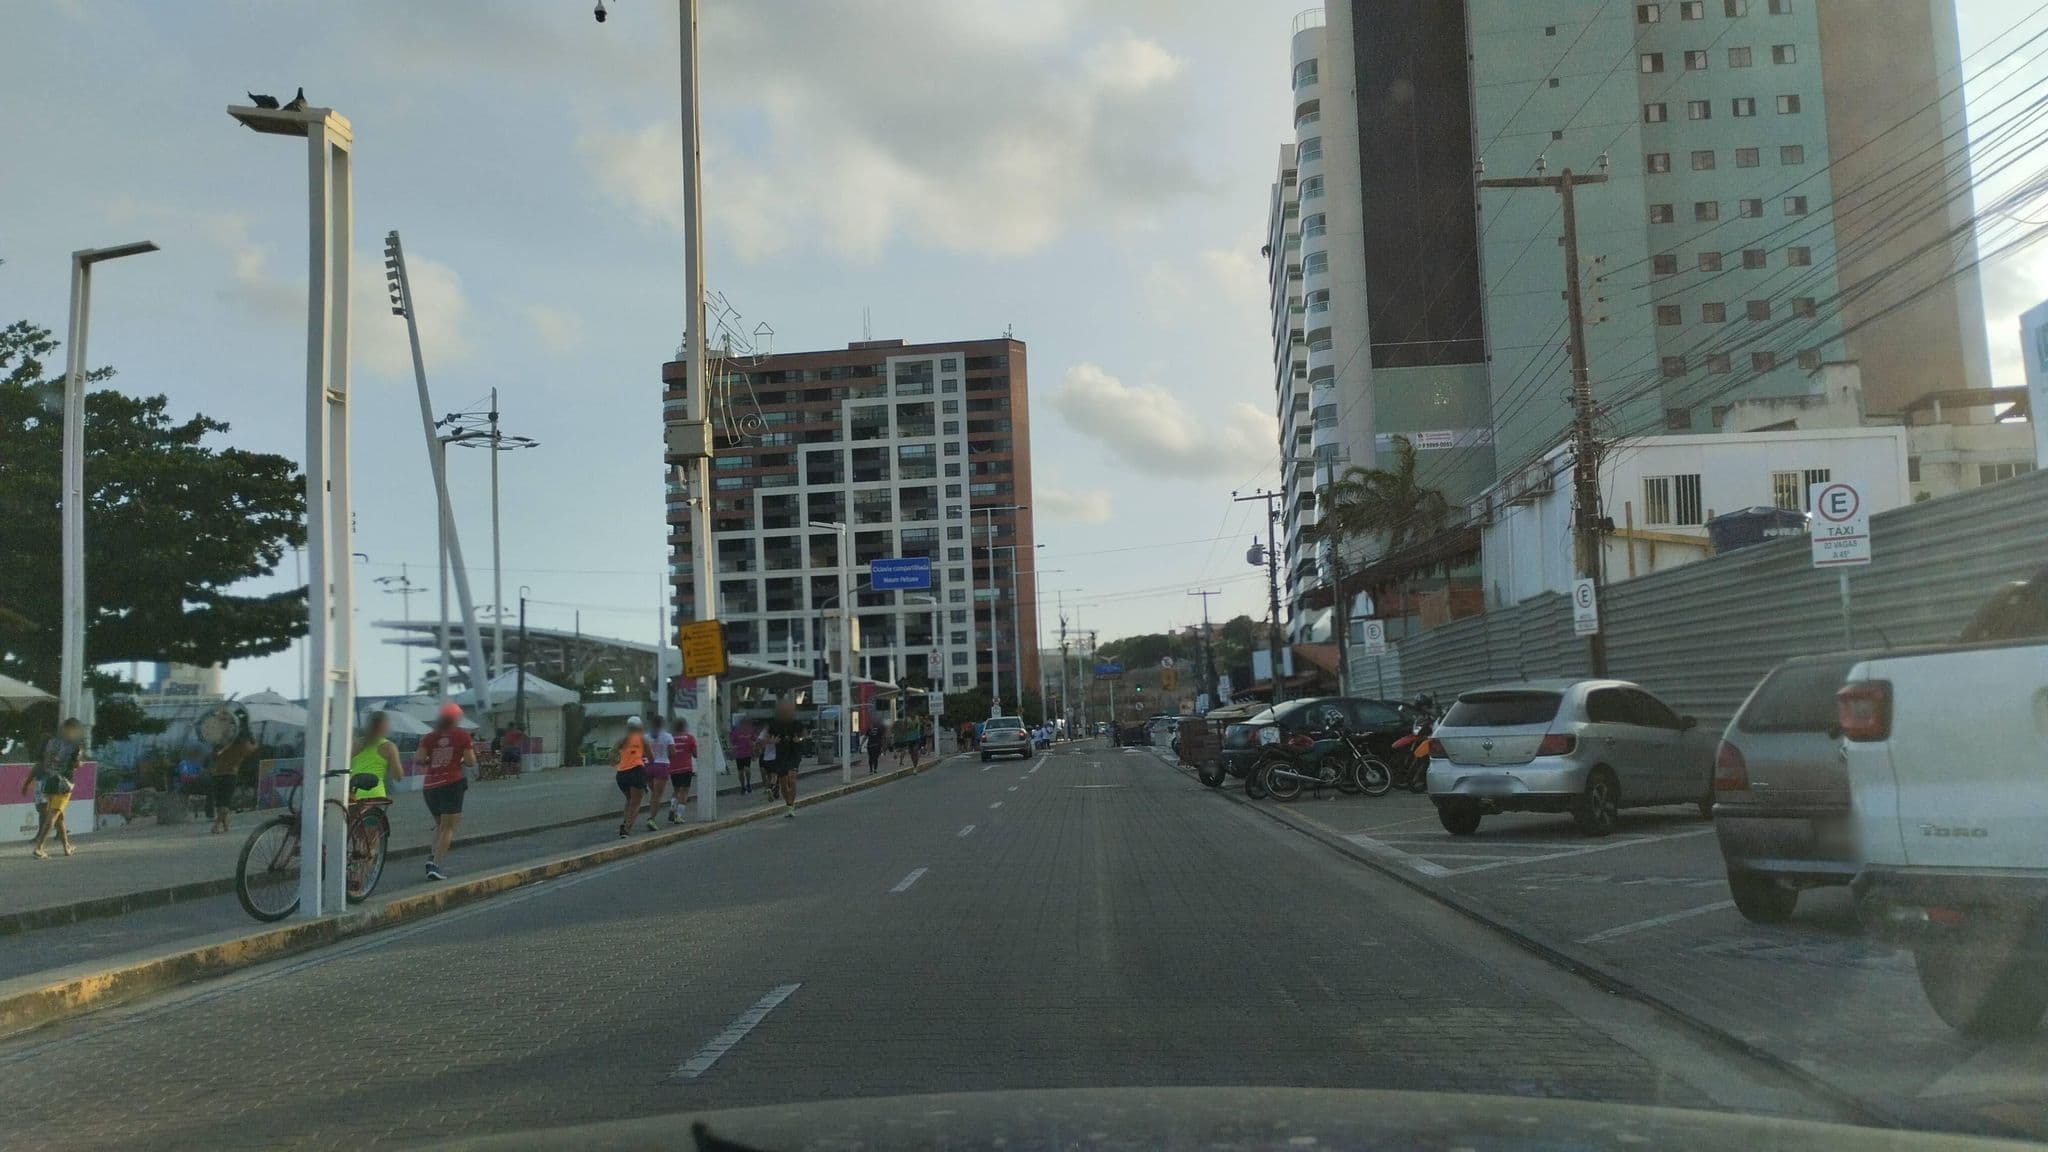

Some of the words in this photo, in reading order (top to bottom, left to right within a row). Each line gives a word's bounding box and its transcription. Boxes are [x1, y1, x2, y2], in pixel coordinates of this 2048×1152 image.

[1831, 492, 1848, 513] E
[1826, 526, 1855, 537] TAXI
[1834, 539, 1858, 549] VAGAS
[1581, 589, 1589, 603] E
[1370, 626, 1377, 637] E
